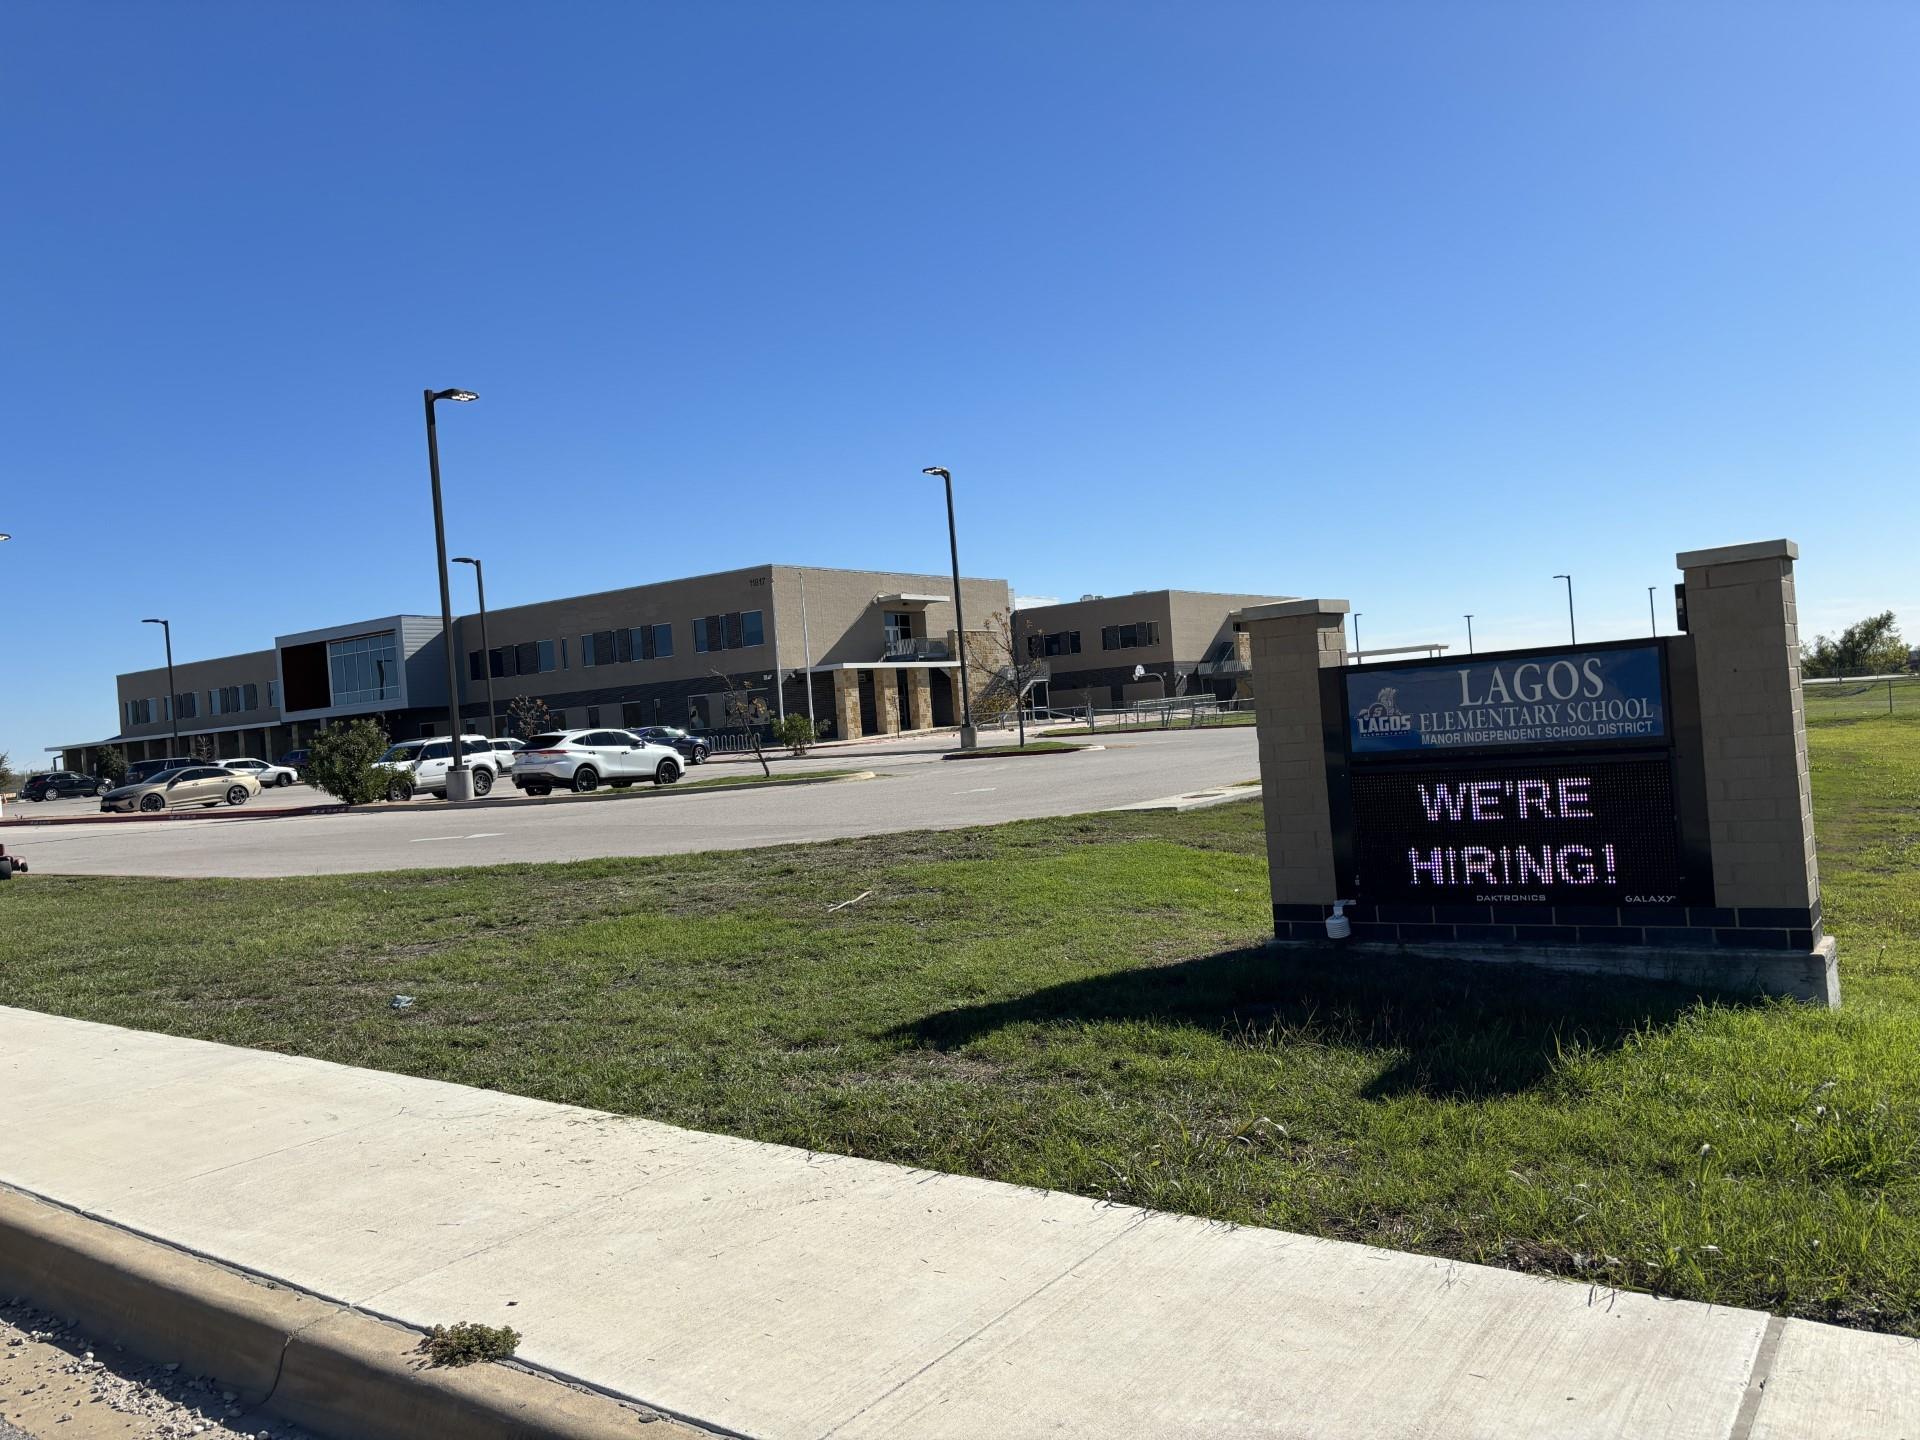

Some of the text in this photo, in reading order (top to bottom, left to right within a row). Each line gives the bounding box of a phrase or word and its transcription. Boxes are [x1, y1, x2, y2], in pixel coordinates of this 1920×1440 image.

[1458, 657, 1604, 707] LAGOS
[1357, 714, 1411, 733] LAGOS
[1419, 697, 1654, 733] ELEMENTARY SCHOOL
[1421, 720, 1653, 745] MANOR INDEPENDENT SCHOOL DISTRICT
[1418, 777, 1594, 822] WE'RE
[1408, 844, 1617, 885] HIRING!
[1476, 894, 1547, 903] DAKTRONICS
